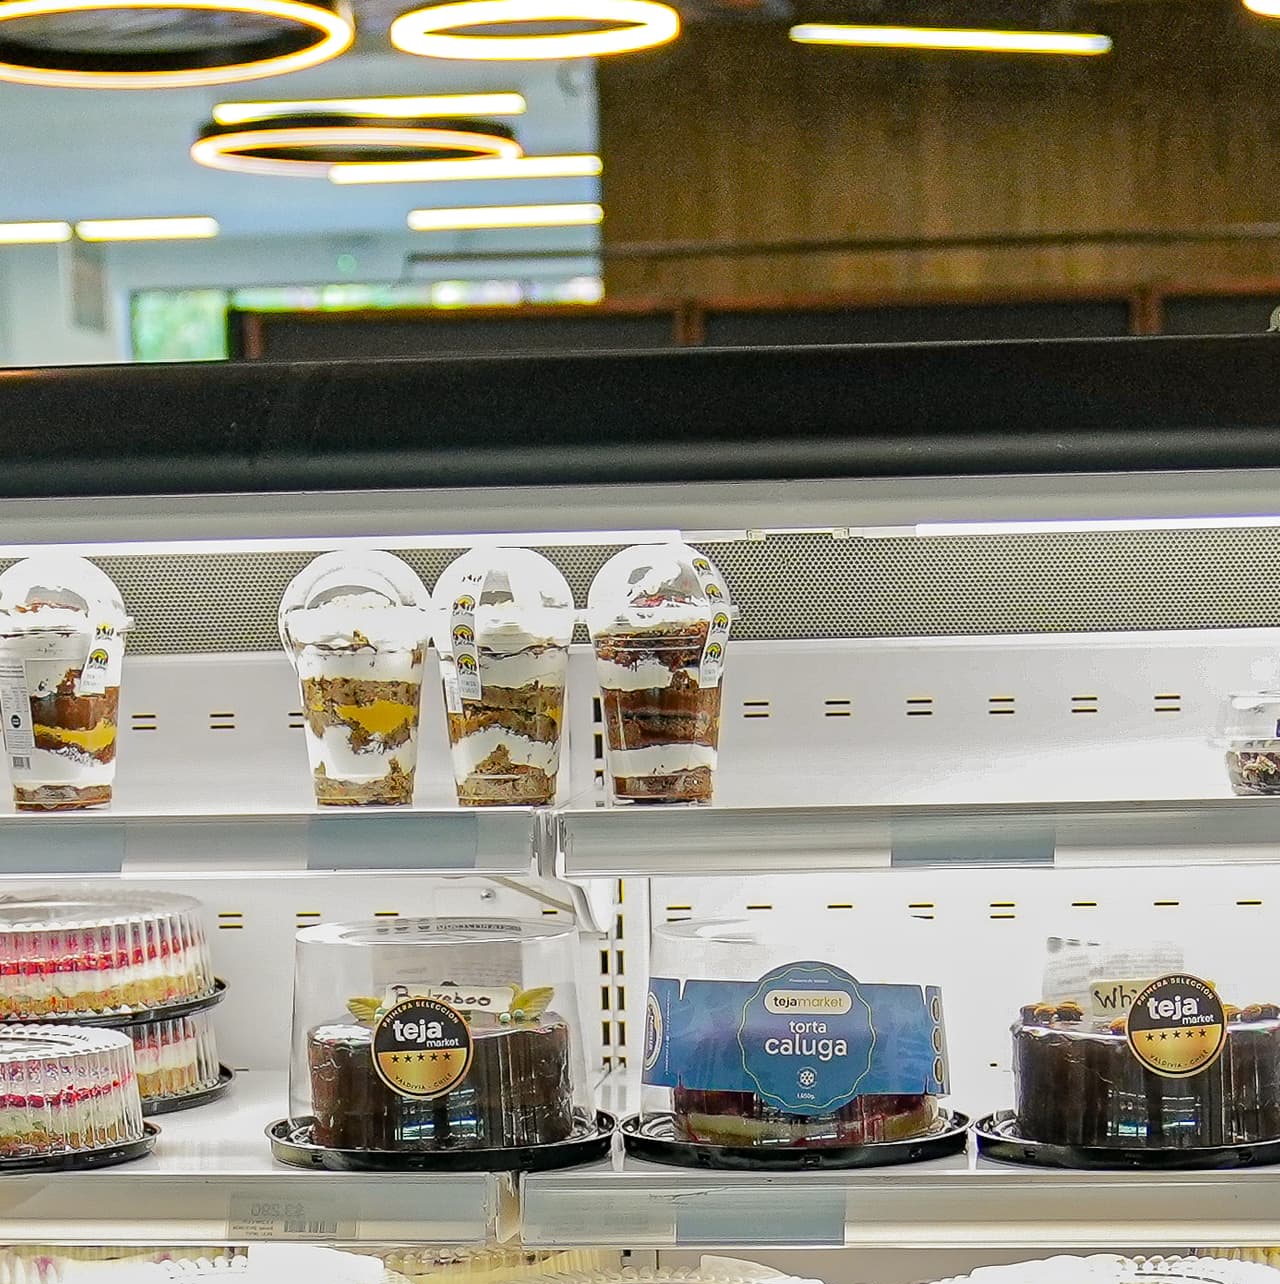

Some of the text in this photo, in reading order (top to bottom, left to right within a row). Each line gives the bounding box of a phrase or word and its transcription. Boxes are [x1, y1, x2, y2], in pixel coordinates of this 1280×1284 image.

[773, 996, 843, 1008] tejamarket
[1147, 996, 1198, 1020] teja
[789, 1020, 827, 1034] torta
[1182, 1015, 1214, 1025] market
[393, 1019, 442, 1042] teja
[426, 1038, 459, 1047] market
[764, 1034, 848, 1061] caluga
